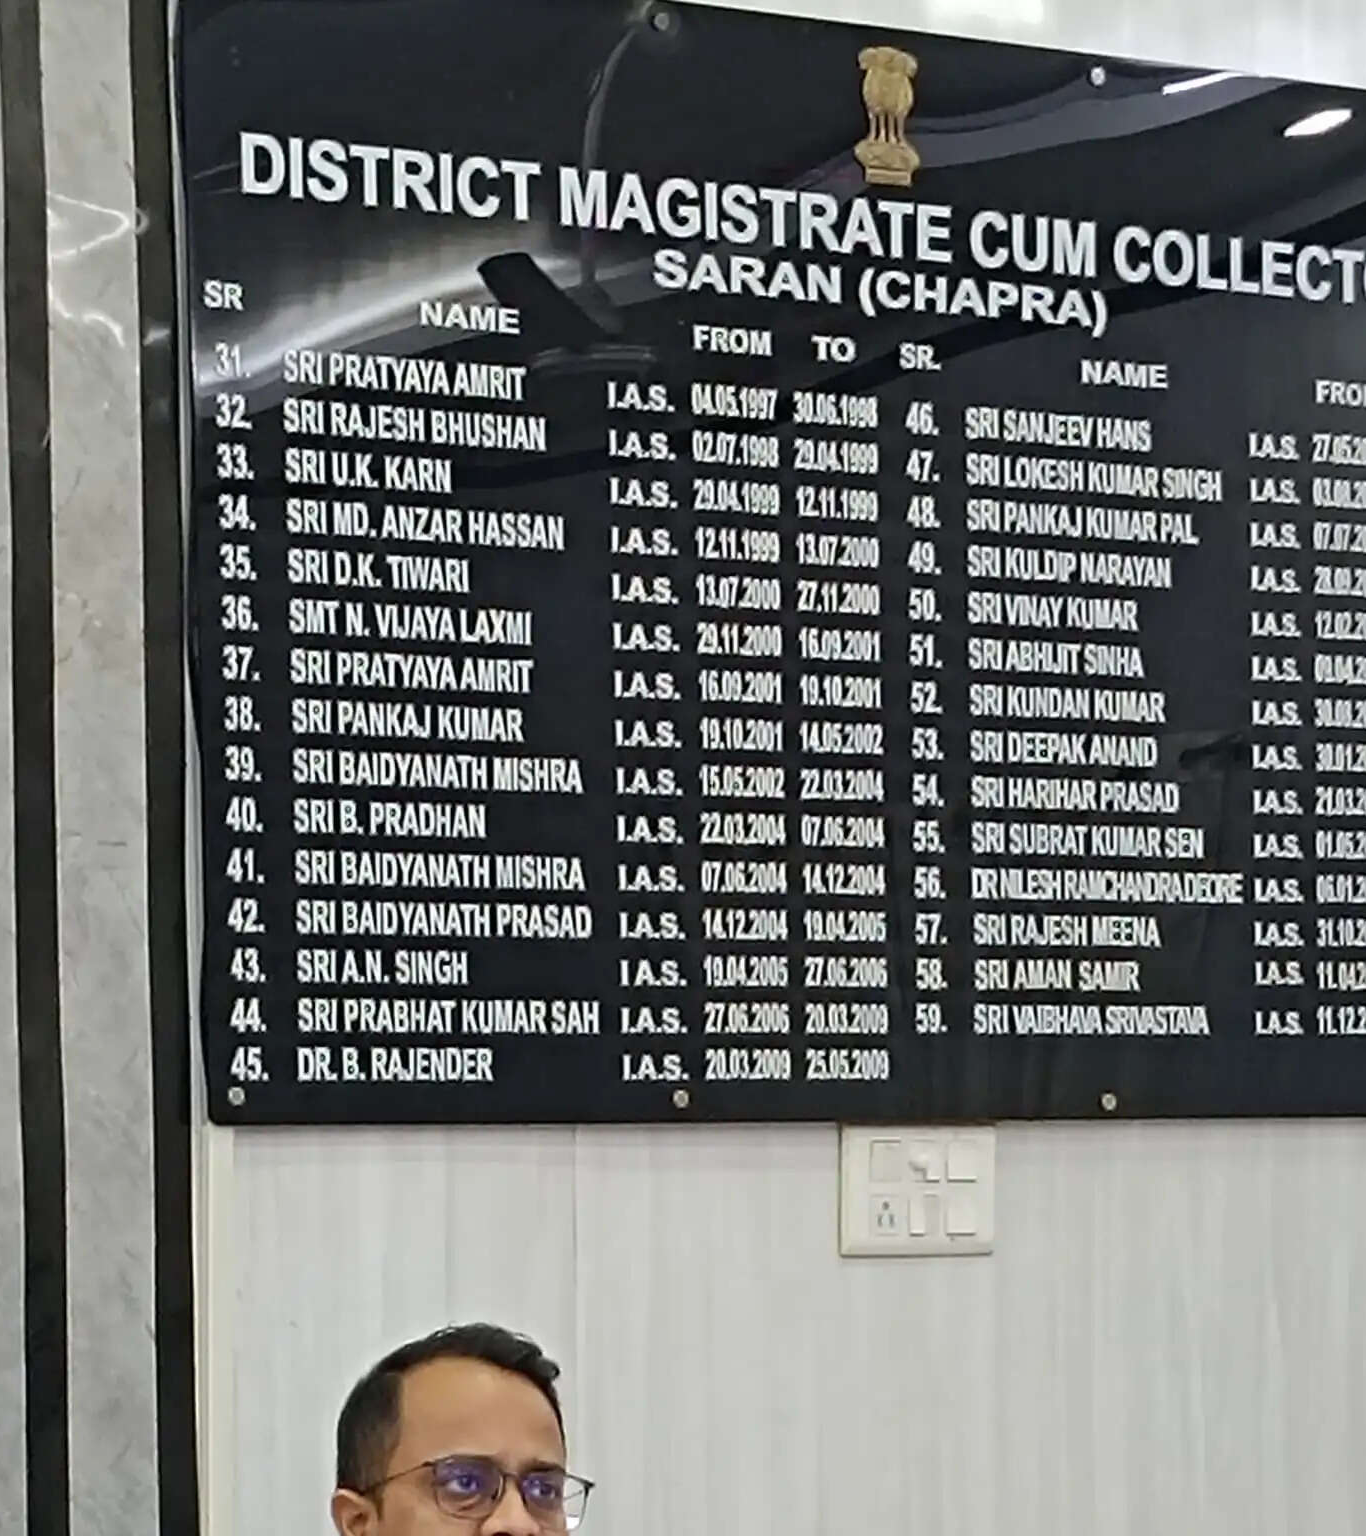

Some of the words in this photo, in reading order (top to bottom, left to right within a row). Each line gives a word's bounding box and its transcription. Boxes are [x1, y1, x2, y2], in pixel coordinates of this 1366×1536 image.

[241, 132, 541, 220] DISTRICT
[559, 162, 952, 267] MAGISTRATE
[970, 211, 1096, 277] CUM
[654, 249, 841, 303] SARAN
[859, 263, 1106, 337] (CHAPRA)
[418, 298, 519, 334] NAME
[694, 325, 771, 356] FROM
[812, 336, 855, 361] TO
[900, 343, 941, 370] SR.
[1081, 360, 1168, 388] NAME
[215, 342, 251, 377] 31.
[282, 346, 324, 384] SRI
[328, 348, 449, 395] PRATYAYA
[453, 363, 526, 400] AMRIT
[608, 382, 675, 412] I.A.S.
[692, 383, 777, 419] 04.05.1997
[216, 392, 252, 429] 32.
[284, 398, 324, 434] SRI
[330, 402, 425, 441] RAJESH
[431, 410, 546, 451] BHUSHAN
[906, 402, 939, 435] 46.
[966, 407, 999, 439] SRI
[1004, 410, 1093, 447] SANJEEV
[1097, 418, 1151, 451] HANS
[217, 444, 254, 479] 33.
[285, 448, 325, 483] SRI
[332, 452, 378, 487] U.K.
[385, 456, 451, 493] KARN
[907, 449, 939, 482] 47.
[967, 453, 999, 486] SRI
[1004, 456, 1083, 491] LOKESH
[1088, 462, 1159, 497] KUMAR
[1163, 468, 1222, 501] SINGH
[219, 494, 256, 530] 34.
[287, 499, 327, 534] SRI
[333, 502, 376, 537] MD.
[381, 505, 462, 543] ANZAR
[469, 511, 564, 550] HASSAN
[907, 496, 940, 528] 48.
[967, 499, 1000, 532] SRI
[1005, 502, 1082, 537] PANKAJ
[1087, 507, 1157, 541] KUMAR
[1161, 513, 1199, 544] PAL
[220, 544, 256, 580] 35.
[288, 549, 328, 584] SRI
[334, 552, 381, 587] D.K.
[386, 555, 469, 592] TIWARI
[908, 541, 941, 574] 49.
[968, 545, 1000, 577] SRI
[1006, 547, 1076, 582] KULDIP
[1081, 552, 1171, 588] NARAYAN
[222, 595, 258, 630] 36.
[290, 599, 339, 634] SMT
[346, 603, 369, 636] N.
[375, 604, 455, 641] VIJAYA
[460, 609, 531, 645] LAXMI
[909, 588, 941, 621] 50.
[968, 591, 1001, 623] SRI
[1005, 594, 1063, 628] VINAY
[1067, 597, 1138, 631] KUMAR
[223, 645, 260, 680] 37.
[291, 648, 330, 684] SRI
[337, 652, 457, 690] PRATYAYA
[463, 658, 533, 693] AMRIT
[910, 634, 942, 668] 51.
[969, 638, 1002, 670] SRI
[1005, 641, 1081, 674] ABHIJIT
[1084, 644, 1144, 677] SINHA
[225, 696, 260, 731] 38.
[292, 699, 331, 733] SRI
[338, 701, 430, 738] PANKAJ
[438, 706, 523, 742] KUMAR
[615, 720, 681, 748] I.A.S.
[911, 682, 942, 713] 52.
[970, 684, 1002, 716] SRI
[1008, 686, 1089, 718] KUNDAN
[1095, 690, 1165, 722] KUMAR
[226, 746, 261, 781] 39.
[294, 748, 333, 783] SRI
[339, 751, 487, 789] BAIDYANATH
[494, 758, 583, 793] MISHRA
[912, 728, 943, 760] 53.
[971, 730, 1003, 762] SRI
[1008, 732, 1086, 764] DEEPAK
[1089, 734, 1157, 767] ANAND
[913, 774, 944, 806] 54.
[971, 776, 1004, 808] SRI
[1009, 778, 1096, 810] HARIHAR
[1101, 781, 1179, 813] PRASAD
[226, 797, 262, 832] 40.
[294, 799, 333, 833] SRI
[340, 800, 363, 834] B.
[370, 802, 486, 838] PRADHAN
[618, 816, 683, 844] I.A.S.
[913, 821, 945, 853] 55.
[972, 822, 1004, 853] SRI
[1010, 824, 1088, 855] SUBRAT
[1092, 826, 1161, 857] KUMAR
[1165, 828, 1203, 858] SEN
[227, 848, 264, 883] 41.
[296, 850, 334, 884] SRI
[341, 852, 489, 888] BAIDYANATH
[496, 856, 585, 890] MISHRA
[915, 867, 946, 898] 56.
[971, 868, 998, 899] DR
[228, 898, 264, 932] 42.
[297, 900, 335, 934] SRI
[342, 901, 490, 937] BAIDYANATH
[497, 904, 592, 938] PRASAD
[916, 914, 947, 944] 57.
[974, 913, 1006, 945] SRI
[1011, 915, 1087, 946] RAJESH
[1092, 916, 1161, 947] MEENA
[232, 948, 265, 982] 43.
[298, 949, 336, 982] SRI
[342, 950, 389, 983] A.N.
[395, 950, 467, 984] SINGH
[917, 958, 947, 990] 58.
[975, 960, 1008, 990] SRI
[1014, 960, 1071, 989] AMAN
[1079, 961, 1140, 991] SAMIR
[231, 998, 266, 1032] 44.
[299, 998, 337, 1032] SRI
[344, 999, 456, 1032] PRABHAT
[462, 1000, 546, 1033] KUMAR
[552, 1001, 599, 1034] SAH
[916, 1004, 947, 1033] 59.
[974, 1004, 1009, 1034] SRI
[1013, 1005, 1103, 1034] VAIBHAVA
[1105, 1006, 1209, 1034] SRIVASTAVA
[231, 1047, 268, 1080] 45.
[298, 1047, 337, 1081] DR.
[343, 1047, 365, 1080] B.
[372, 1048, 493, 1081] RAJENDER
[623, 1055, 688, 1080] I.A.S.
